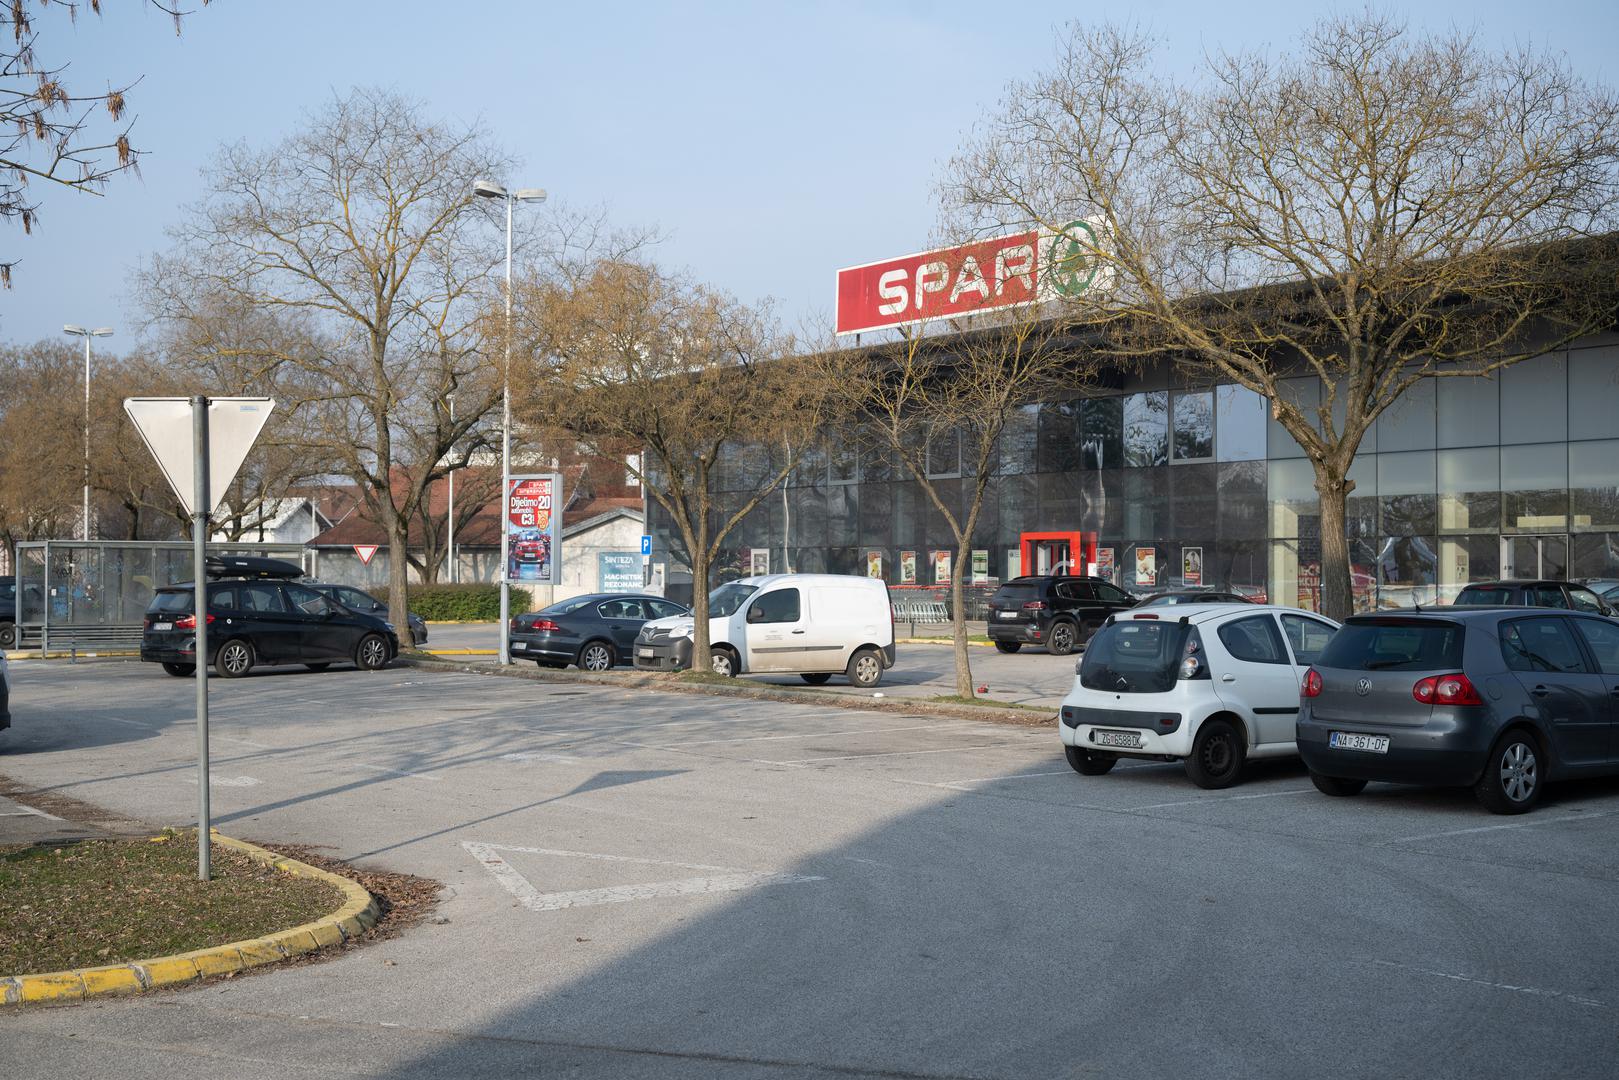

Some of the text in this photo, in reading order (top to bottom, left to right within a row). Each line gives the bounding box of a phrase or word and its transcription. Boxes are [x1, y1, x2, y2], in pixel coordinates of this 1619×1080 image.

[878, 244, 1034, 316] SPAR
[538, 495, 551, 510] 20
[521, 514, 535, 525] C3!
[643, 539, 649, 551] P
[1336, 734, 1387, 750] NA 361-DF
